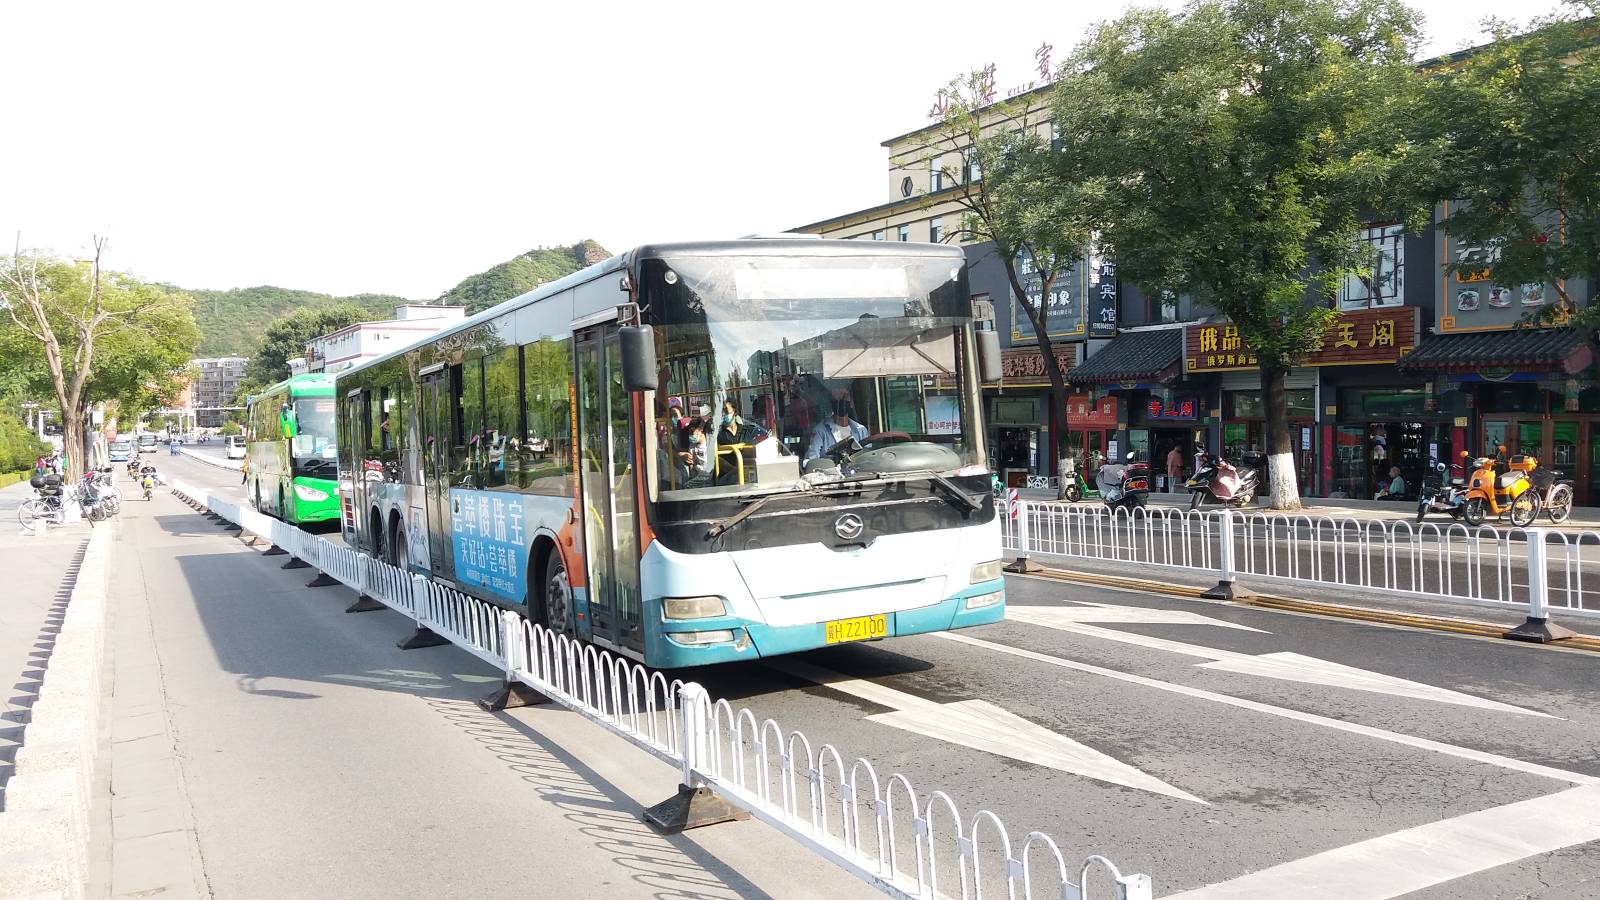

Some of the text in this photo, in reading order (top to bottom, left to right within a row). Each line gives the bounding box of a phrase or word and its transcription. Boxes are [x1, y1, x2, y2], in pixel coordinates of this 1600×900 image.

[1207, 353, 1258, 366] 俄罗斯商品
